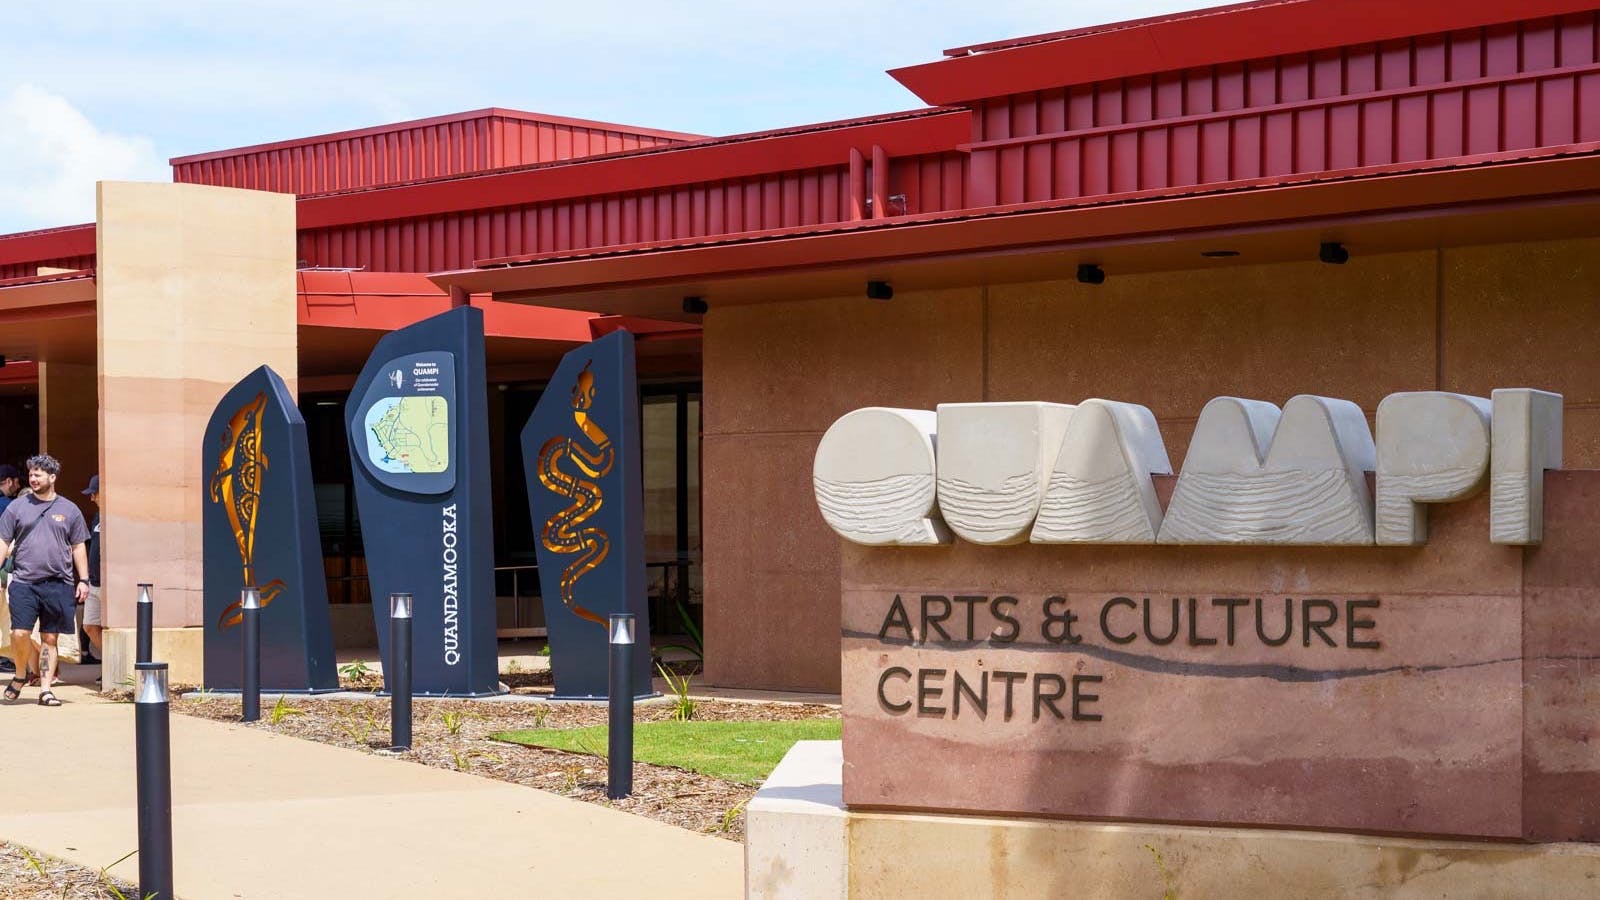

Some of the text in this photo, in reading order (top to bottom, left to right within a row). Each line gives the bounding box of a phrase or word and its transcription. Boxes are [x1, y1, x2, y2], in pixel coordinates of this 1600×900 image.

[413, 367, 439, 375] QUAMPI
[813, 388, 1562, 547] QUAMPI
[443, 503, 460, 666] QUANDAMOOKA
[878, 593, 1381, 649] ARTS & CULTURE
[877, 666, 1103, 723] CENTRE
